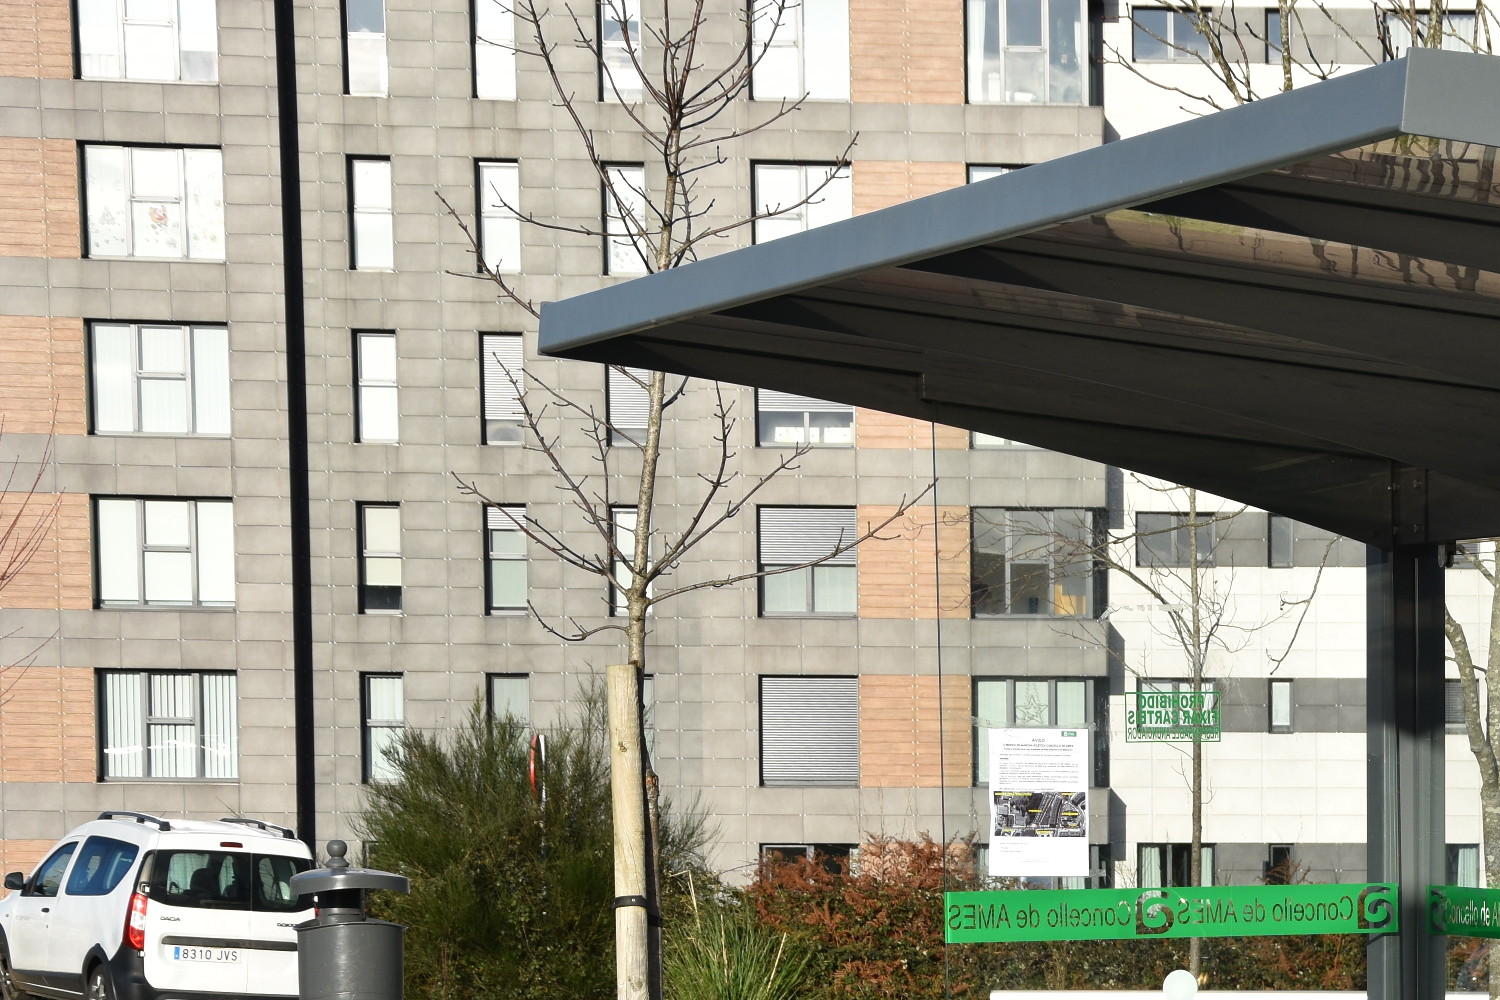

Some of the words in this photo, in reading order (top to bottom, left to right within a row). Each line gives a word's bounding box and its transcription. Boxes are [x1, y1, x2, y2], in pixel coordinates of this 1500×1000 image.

[1445, 898, 1479, 926] Concello
[1480, 900, 1491, 926] de
[182, 948, 212, 960] 8310
[216, 950, 238, 961] JVS
